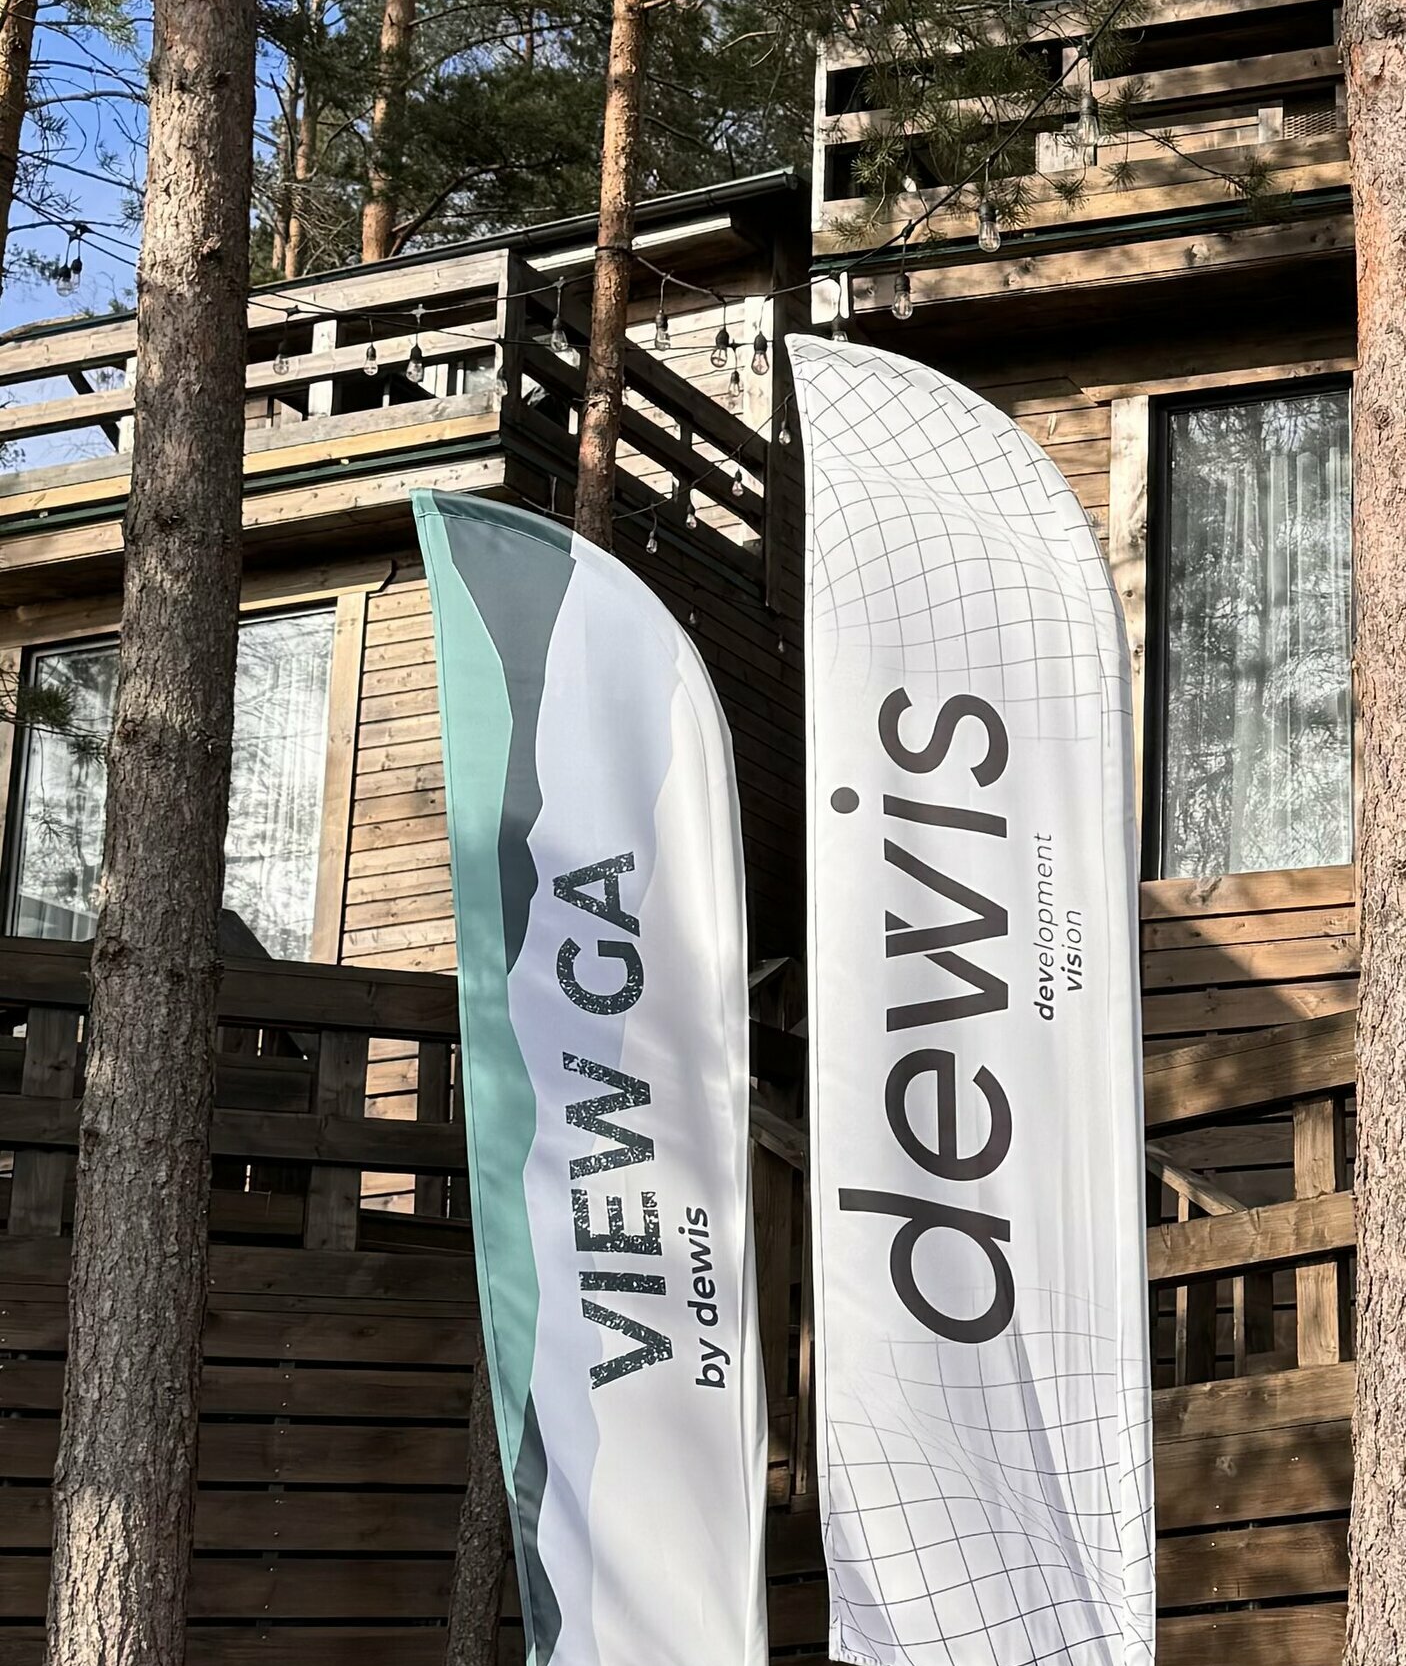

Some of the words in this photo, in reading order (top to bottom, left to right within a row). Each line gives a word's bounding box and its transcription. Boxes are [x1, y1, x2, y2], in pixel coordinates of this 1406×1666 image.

[553, 852, 644, 1016] GA
[1033, 833, 1057, 1020] development
[1061, 910, 1082, 991] vision
[831, 687, 1016, 1344] dewis
[563, 1052, 673, 1390] VIEW
[679, 1207, 719, 1327] dewis
[696, 1338, 731, 1389] by
